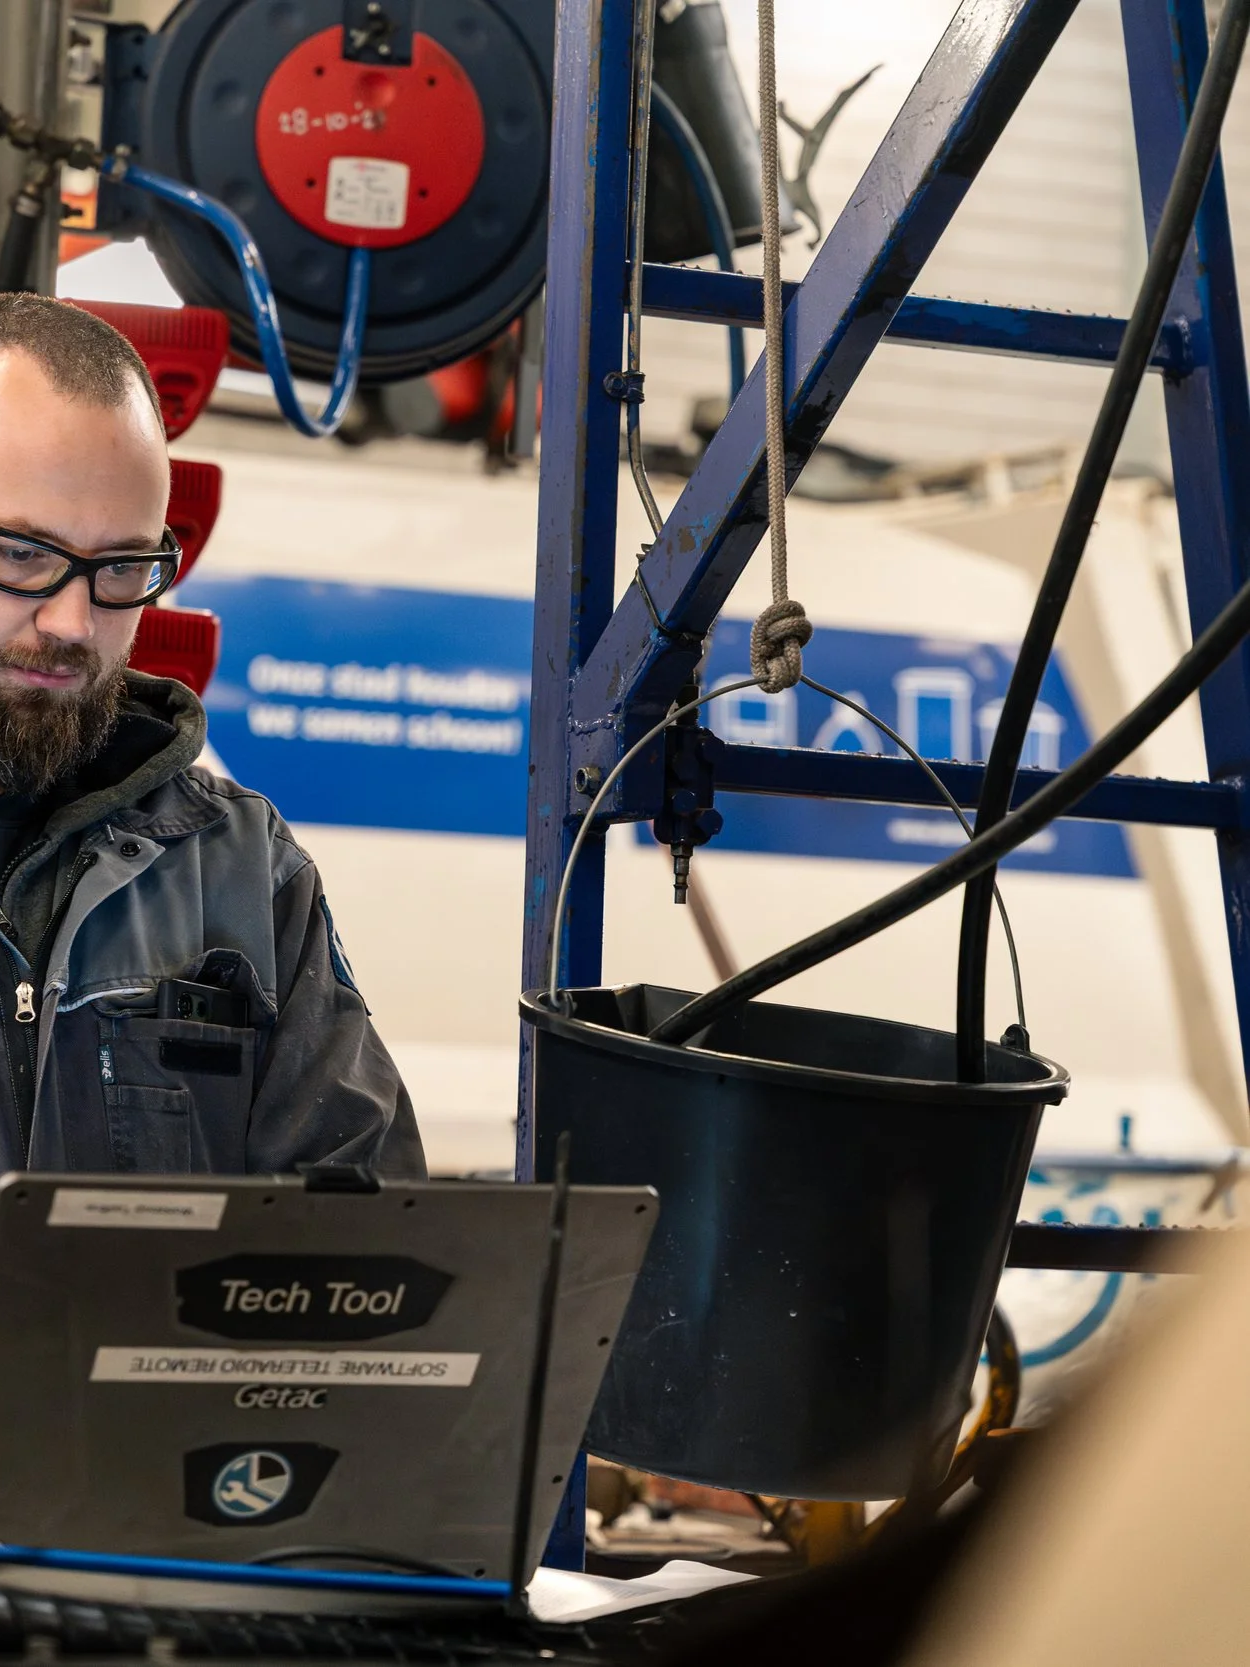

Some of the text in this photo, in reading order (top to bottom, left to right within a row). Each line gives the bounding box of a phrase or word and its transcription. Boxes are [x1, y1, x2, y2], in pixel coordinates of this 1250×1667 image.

[220, 1279, 406, 1315] Tech Tool
[129, 1356, 448, 1378] SOFTWARE TELERADIO REMOTE
[233, 1385, 327, 1410] Getac
